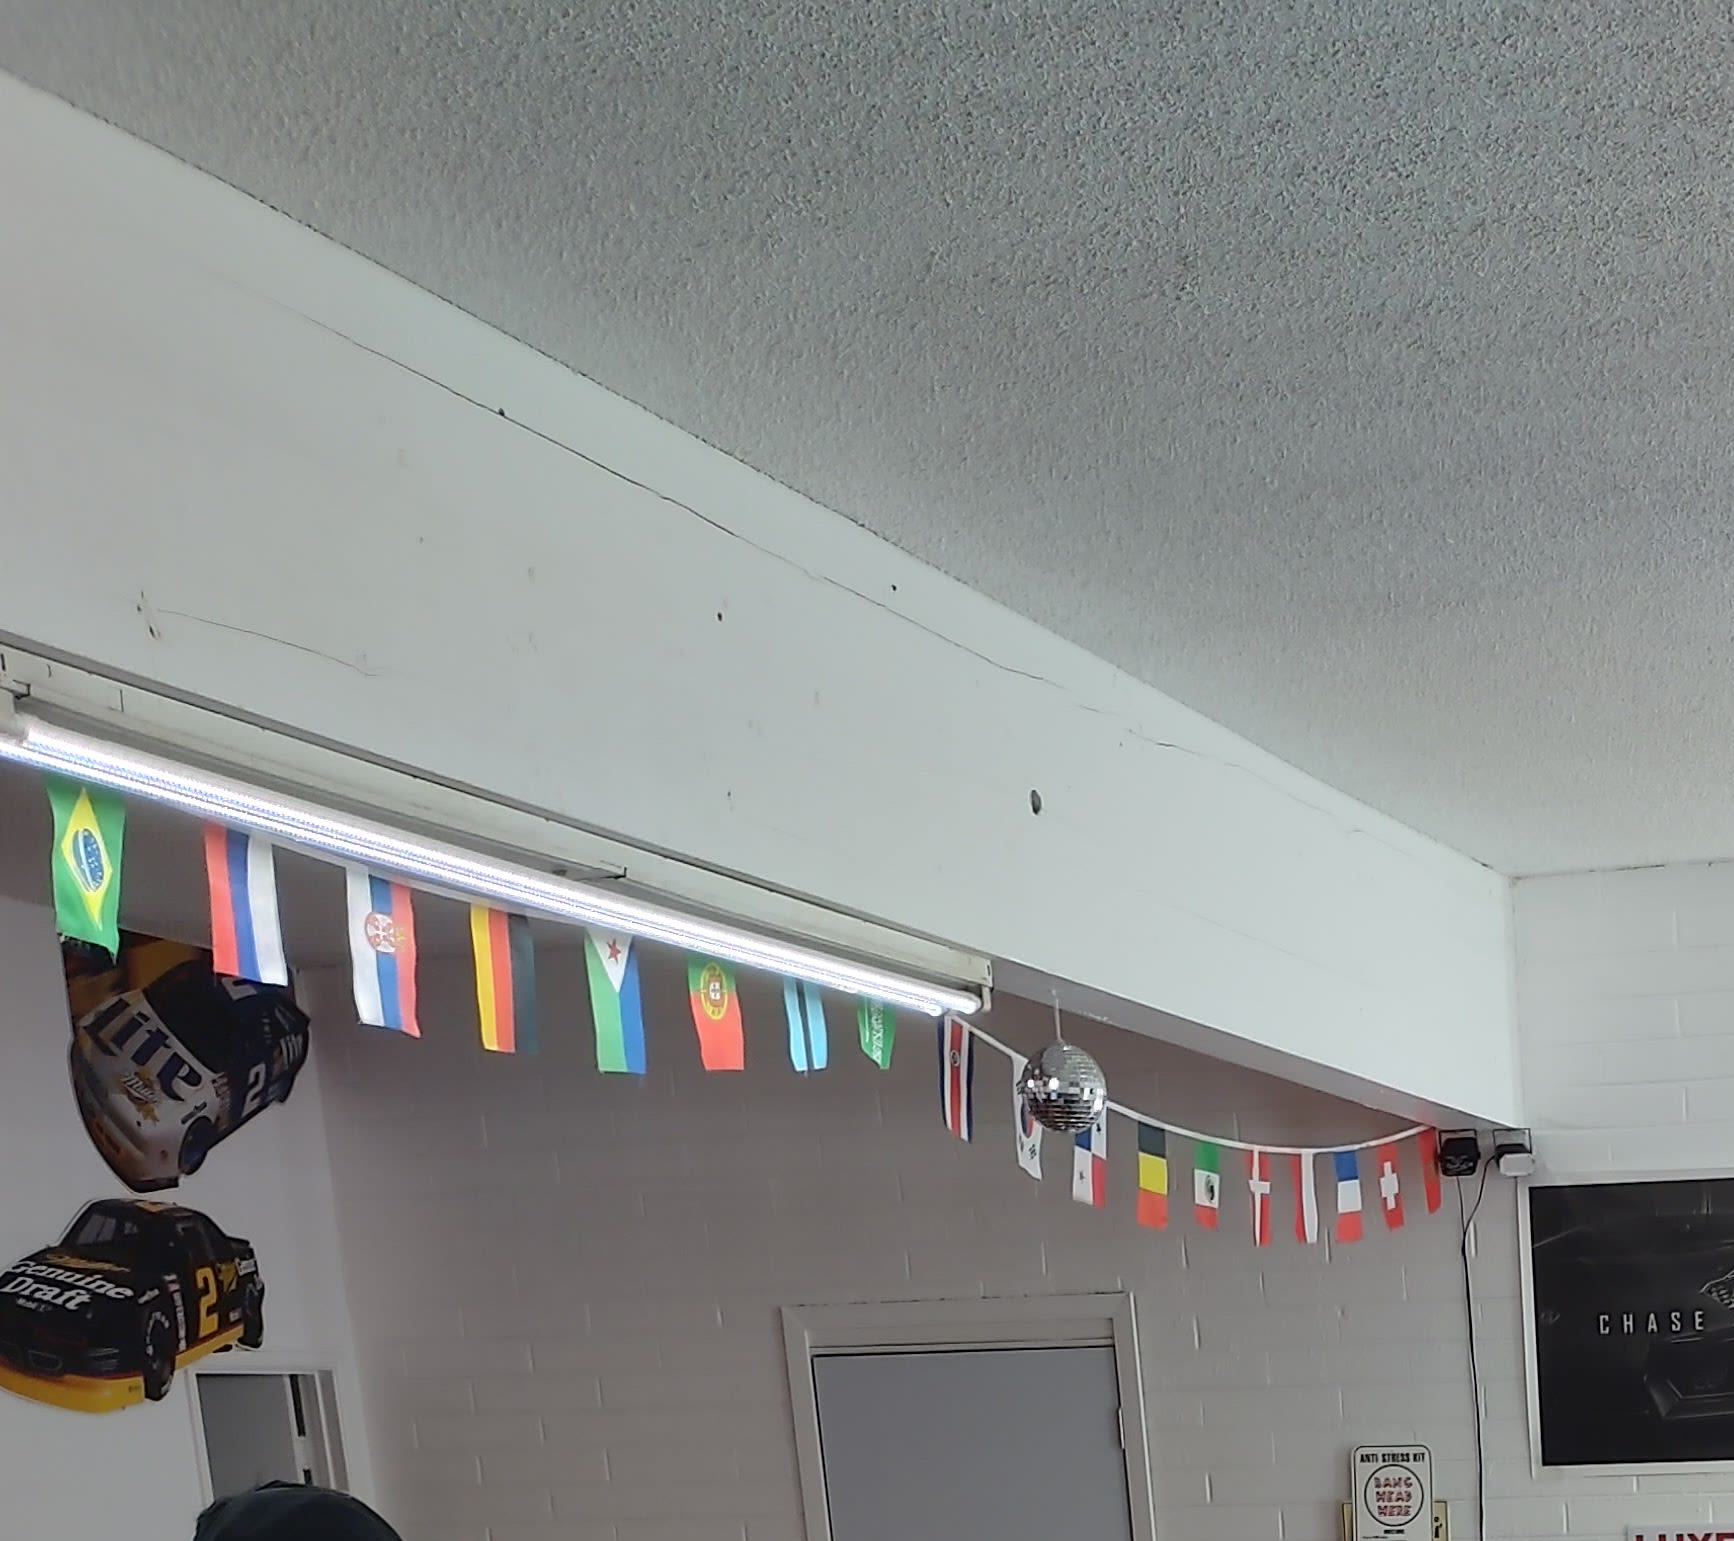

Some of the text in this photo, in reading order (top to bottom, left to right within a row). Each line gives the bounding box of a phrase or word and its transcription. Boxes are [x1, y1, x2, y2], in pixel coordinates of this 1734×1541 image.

[0, 1277, 94, 1311] Draft
[11, 1261, 134, 1299] Genuine
[196, 1266, 219, 1338] 2
[1599, 1311, 1704, 1335] CHASE
[1360, 1453, 1379, 1463] ANTI
[1413, 1452, 1425, 1463] KIT
